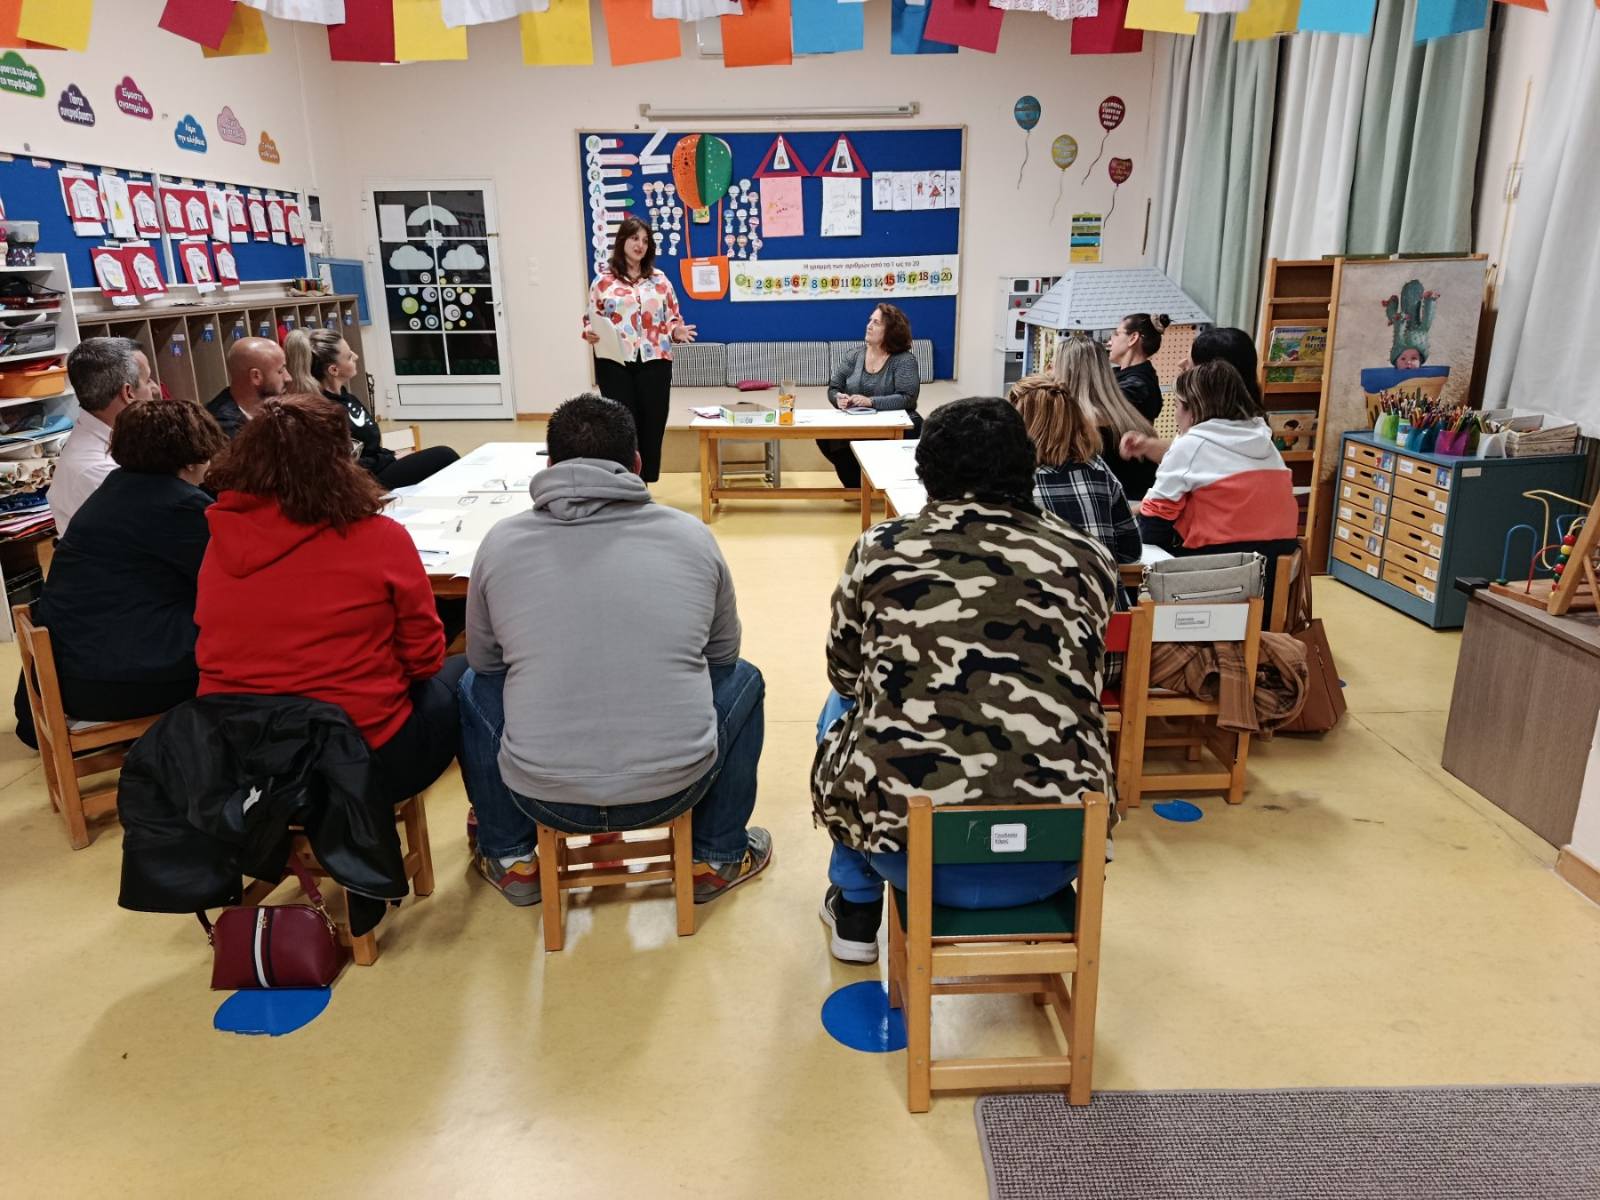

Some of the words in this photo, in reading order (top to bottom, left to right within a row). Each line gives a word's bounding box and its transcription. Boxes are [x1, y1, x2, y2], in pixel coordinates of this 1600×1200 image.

[747, 279, 751, 287] 1
[756, 280, 762, 288] 2
[765, 280, 772, 288] 3
[775, 280, 782, 288] 4
[784, 278, 790, 286] 5
[792, 277, 799, 286] 6
[801, 278, 807, 286] 7
[811, 280, 818, 288] 8
[821, 279, 828, 288] 9
[831, 279, 839, 287] 10
[841, 279, 849, 287] 11
[851, 278, 861, 286] 12
[863, 279, 872, 287] 13
[874, 279, 883, 287] 14
[885, 275, 895, 284] 15
[897, 274, 906, 283] 16
[908, 275, 917, 284] 17
[919, 272, 928, 280] 18
[930, 275, 940, 283] 19
[941, 272, 952, 281] 20
